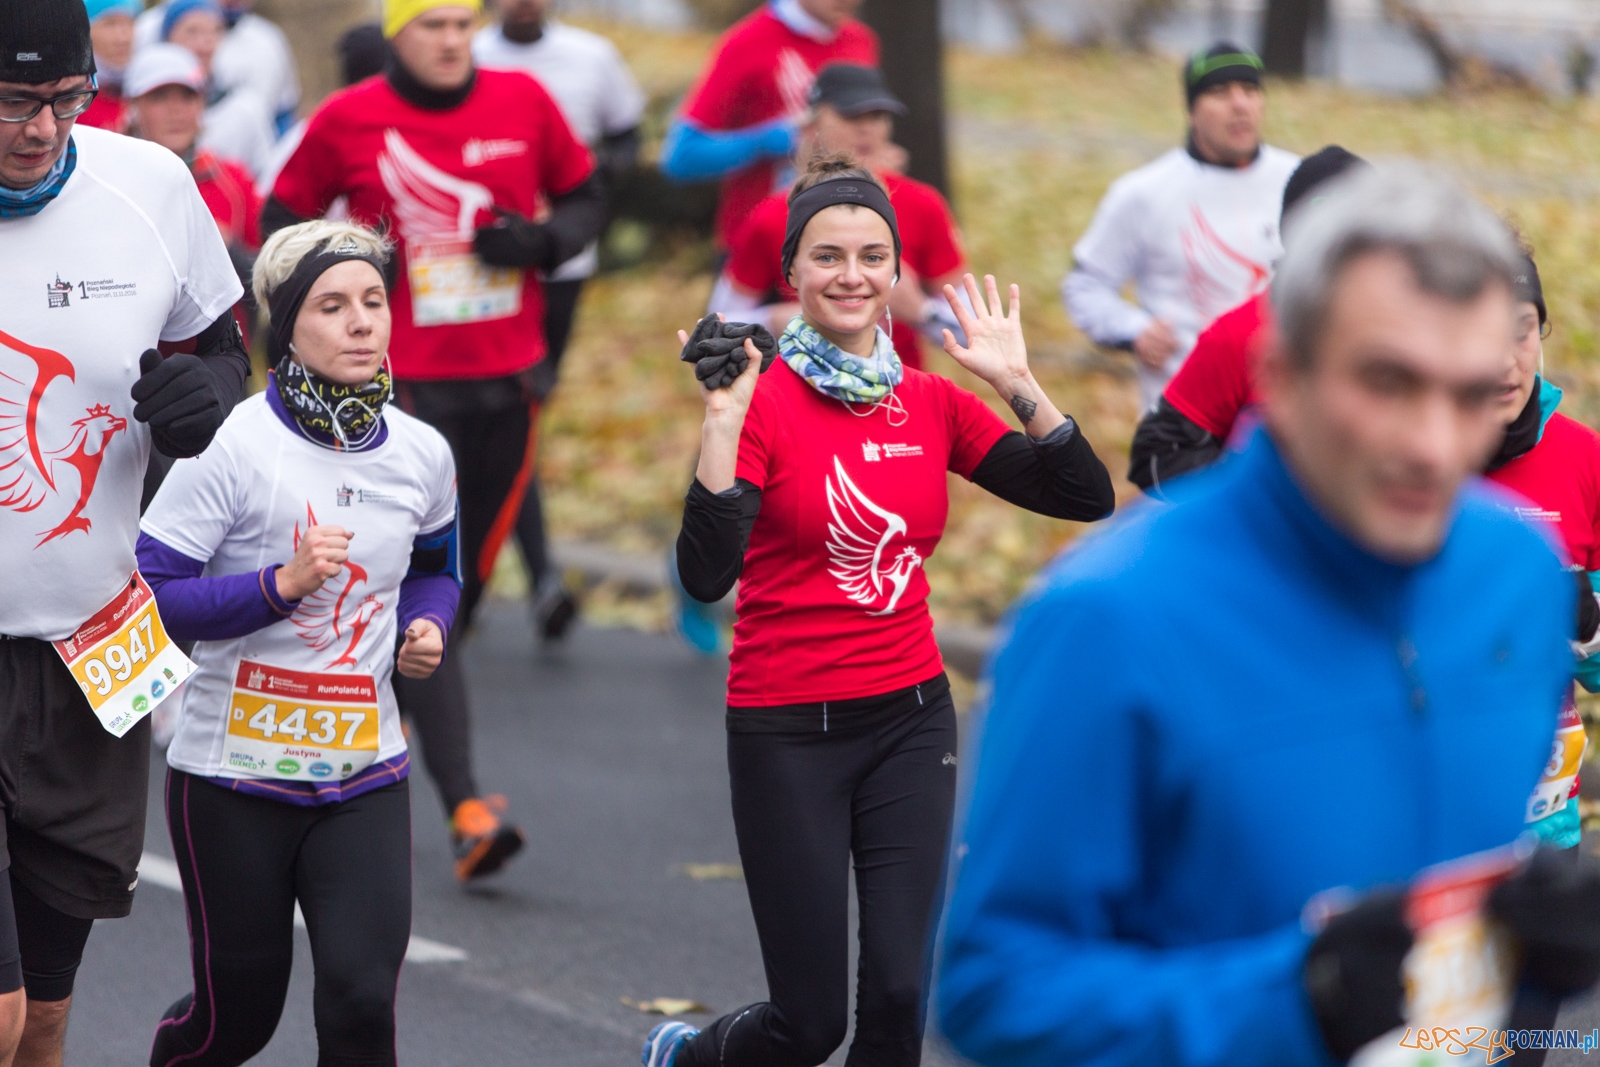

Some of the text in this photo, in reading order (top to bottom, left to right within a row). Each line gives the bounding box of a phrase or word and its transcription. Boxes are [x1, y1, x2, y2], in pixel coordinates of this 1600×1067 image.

[78, 281, 89, 299] 1
[882, 443, 892, 458] 1
[357, 489, 364, 503] 1
[84, 612, 156, 696] 9947
[317, 685, 371, 697] RunPoland.org
[233, 703, 366, 746] D 4437
[230, 751, 253, 762] GRUPA
[283, 748, 322, 759] Justyna
[229, 759, 257, 770] LUXMED
